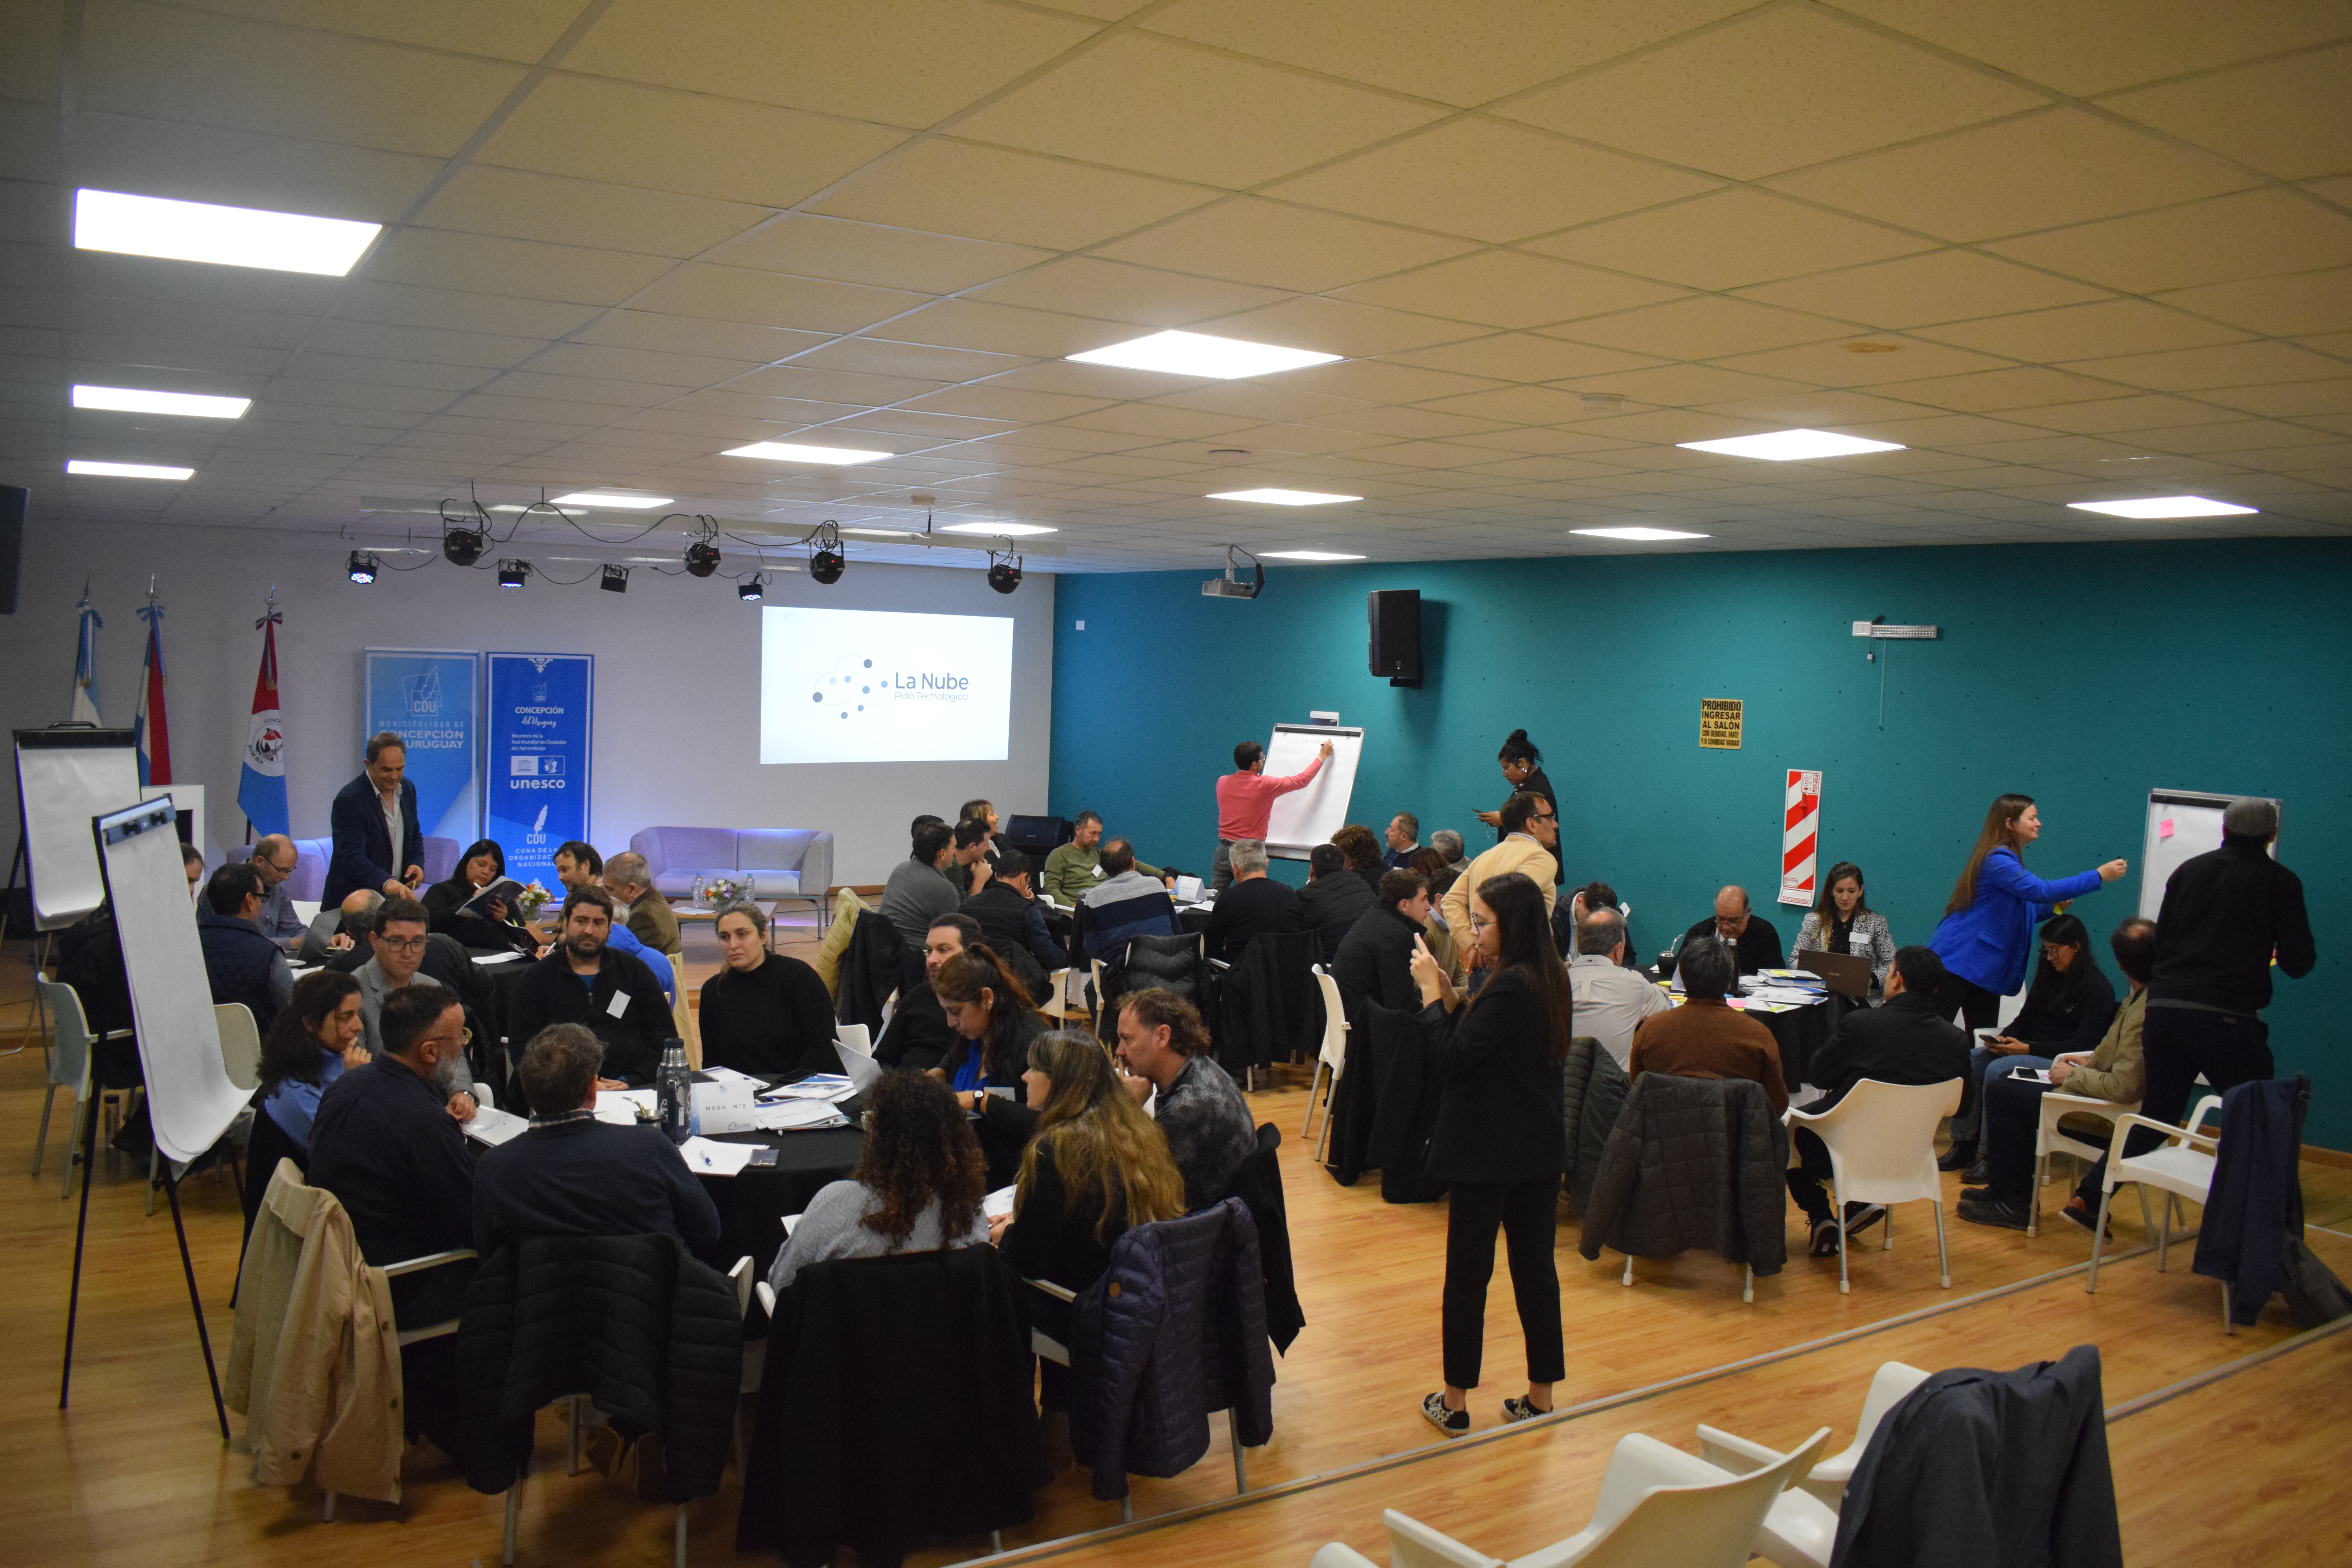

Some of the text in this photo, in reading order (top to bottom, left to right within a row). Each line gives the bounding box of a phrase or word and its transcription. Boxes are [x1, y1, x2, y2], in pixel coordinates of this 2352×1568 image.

[895, 672, 969, 690] La Nube
[895, 691, 968, 702] Polo Tecnológico
[414, 701, 437, 713] CDU
[515, 706, 564, 714] CONCEPCIÓN
[1702, 700, 1741, 711] PROHIBIDO
[1702, 711, 1740, 720] INGRESAR
[532, 717, 556, 728] Uruguay
[1702, 720, 1740, 730] AL SALÓN
[405, 740, 464, 748] URUGUAY
[510, 779, 566, 789] unesco
[526, 833, 546, 844] CDU
